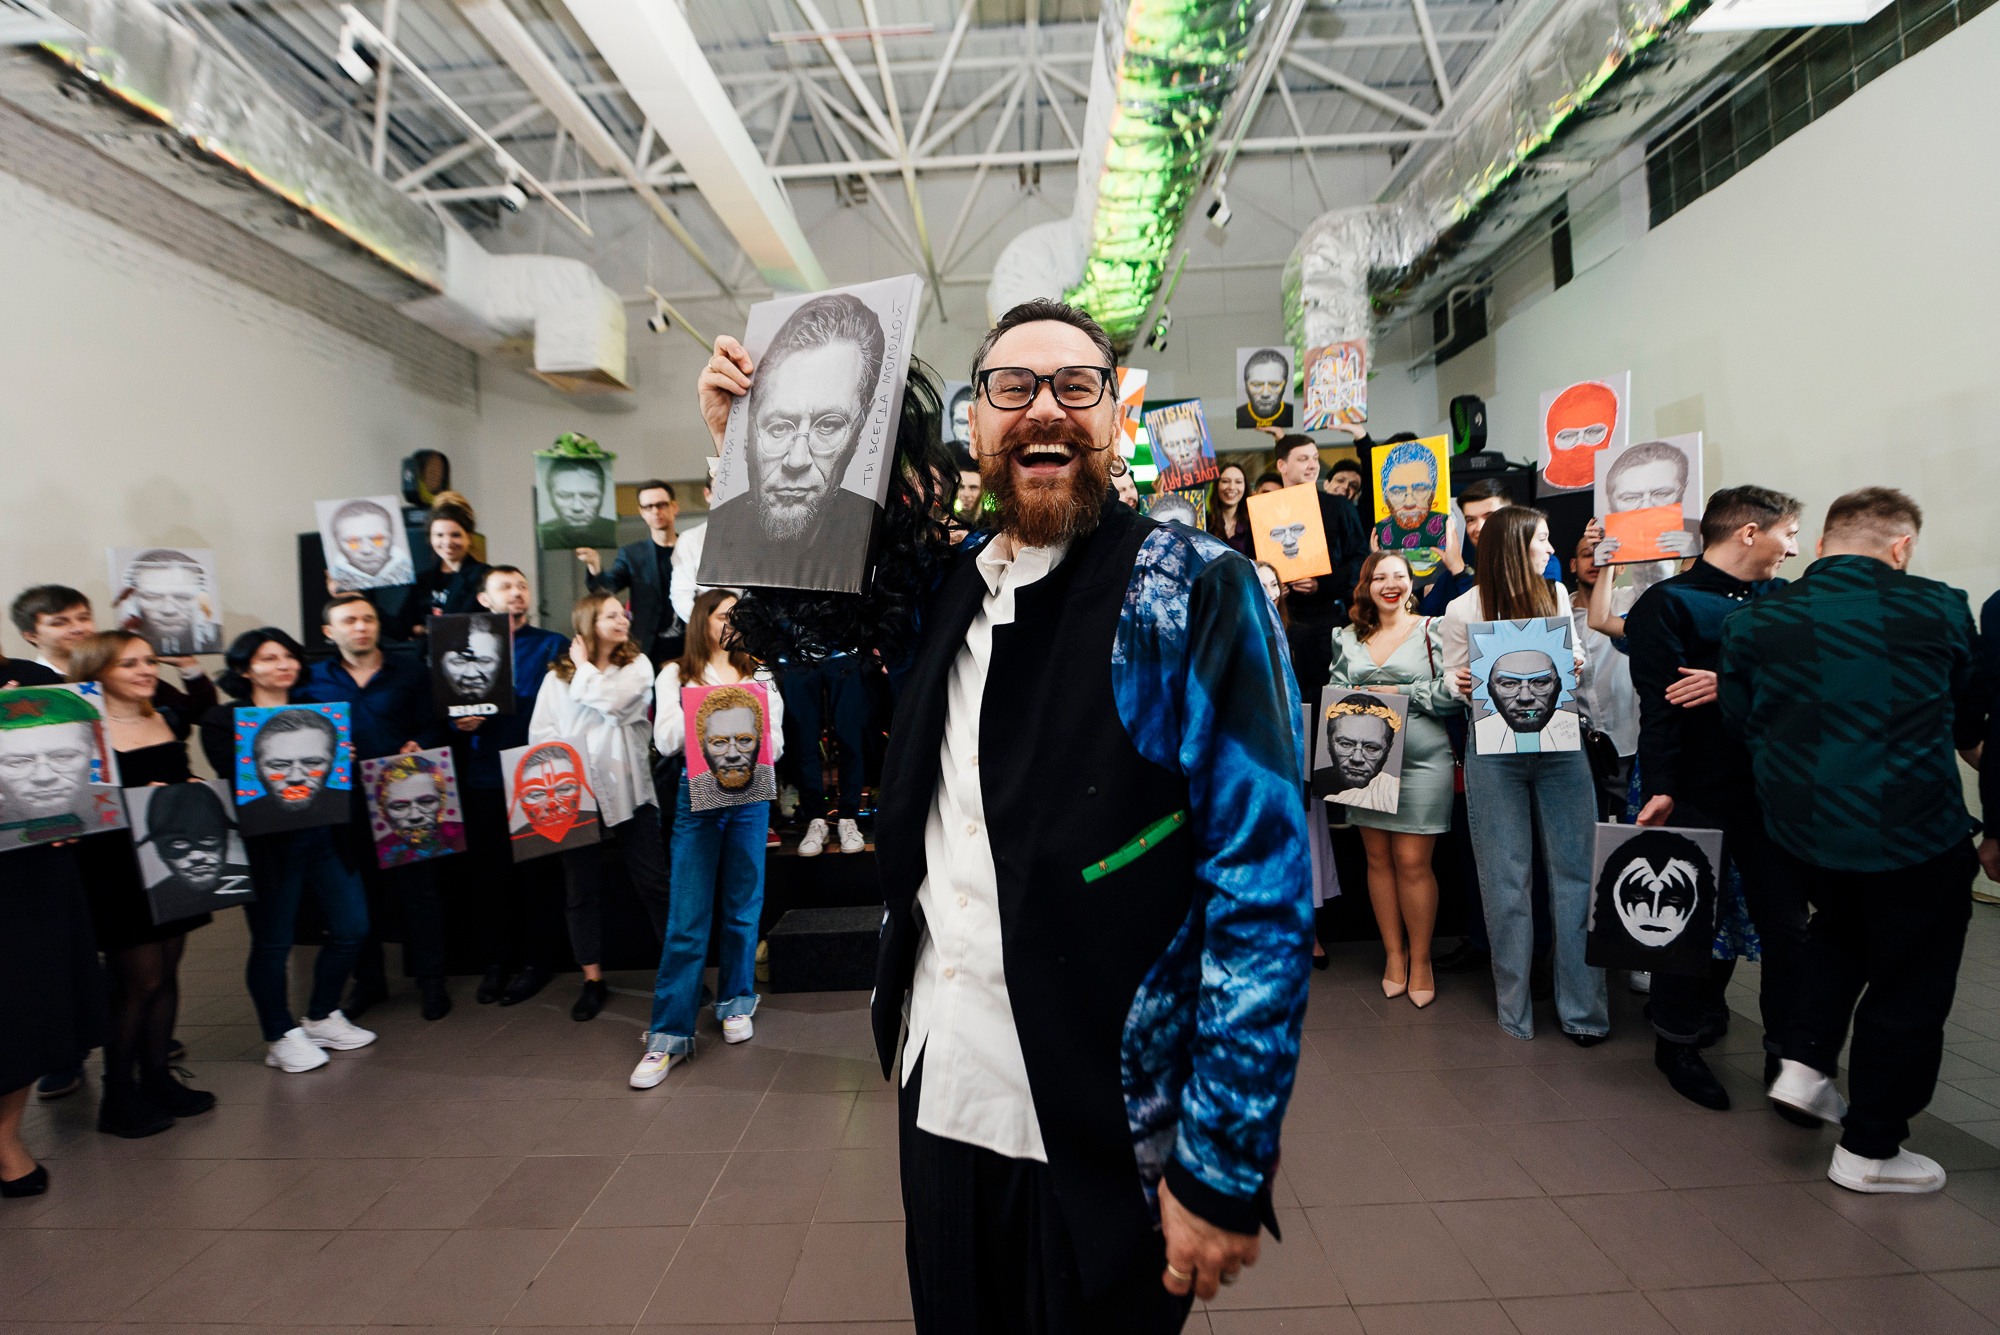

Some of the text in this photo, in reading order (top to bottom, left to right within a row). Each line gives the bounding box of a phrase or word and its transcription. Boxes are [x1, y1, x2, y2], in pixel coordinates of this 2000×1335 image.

[863, 297, 905, 486] ТЫ ВСЕГДА МОЛОДОЙ
[730, 398, 743, 433] СТОР
[1165, 405, 1175, 423] IS
[1175, 400, 1203, 421] LOVE
[1163, 465, 1220, 491] LOVE IS ART
